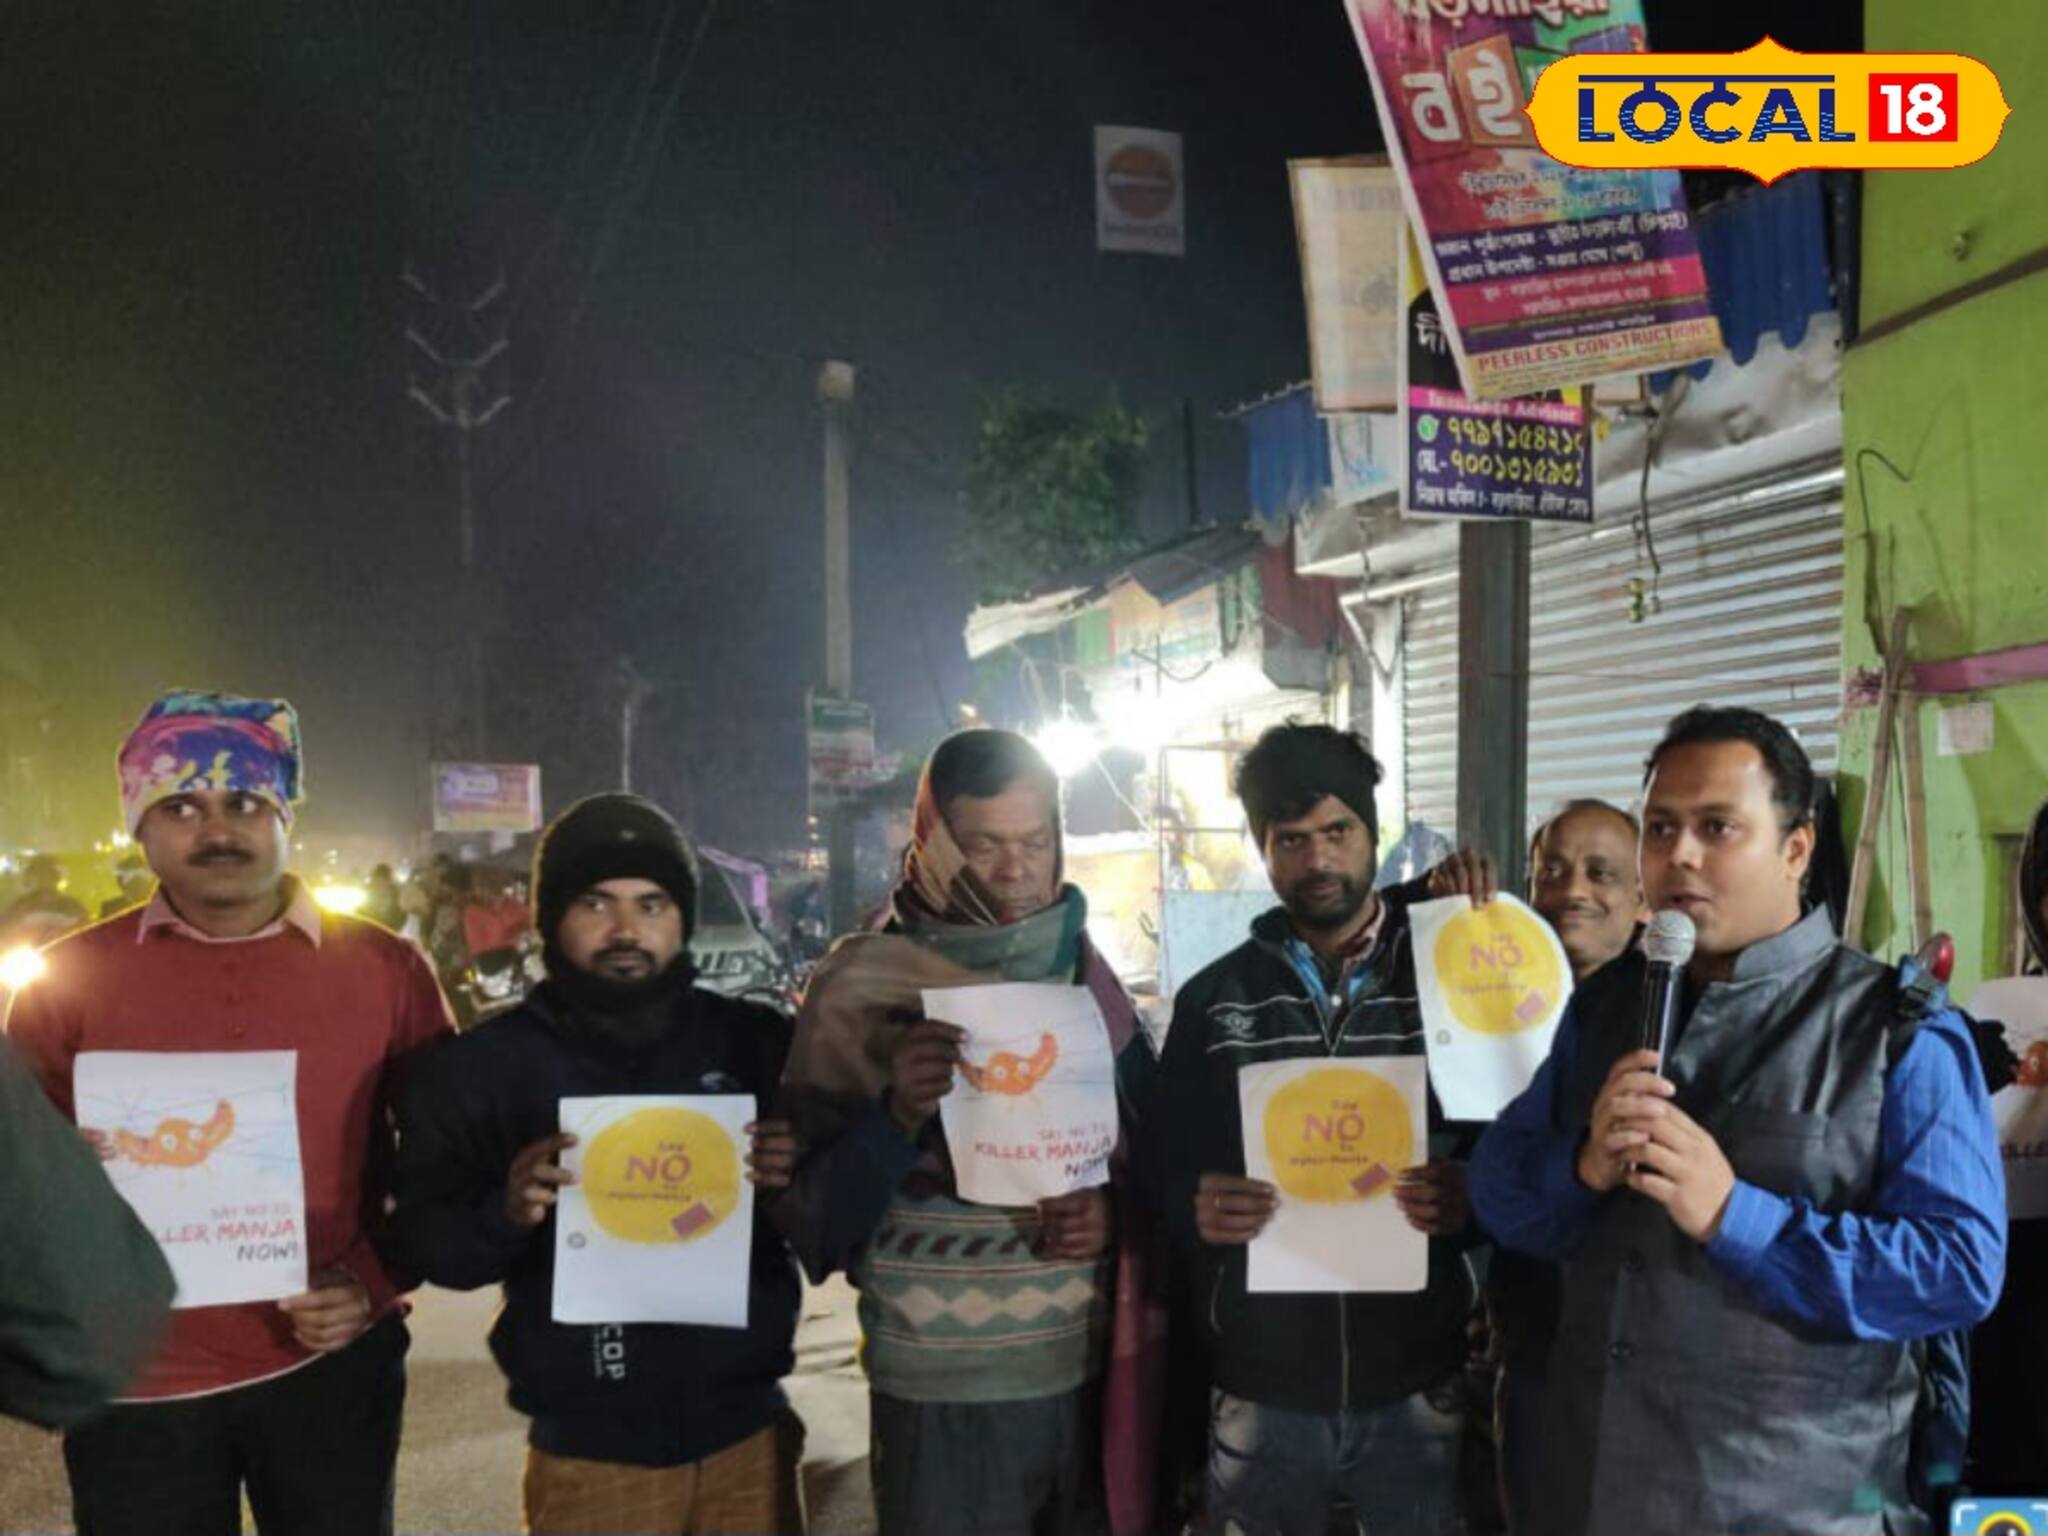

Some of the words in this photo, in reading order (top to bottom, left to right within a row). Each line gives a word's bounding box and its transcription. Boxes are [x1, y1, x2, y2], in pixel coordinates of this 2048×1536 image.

[1478, 341, 1571, 373] PEERLESS
[1575, 321, 1714, 354] CONSTRUCTIONS
[1470, 943, 1524, 972] NO
[1303, 1113, 1366, 1142] NO
[1045, 1133, 1113, 1161] MANJA
[625, 1154, 692, 1184] NO
[216, 1217, 297, 1243] MANJA
